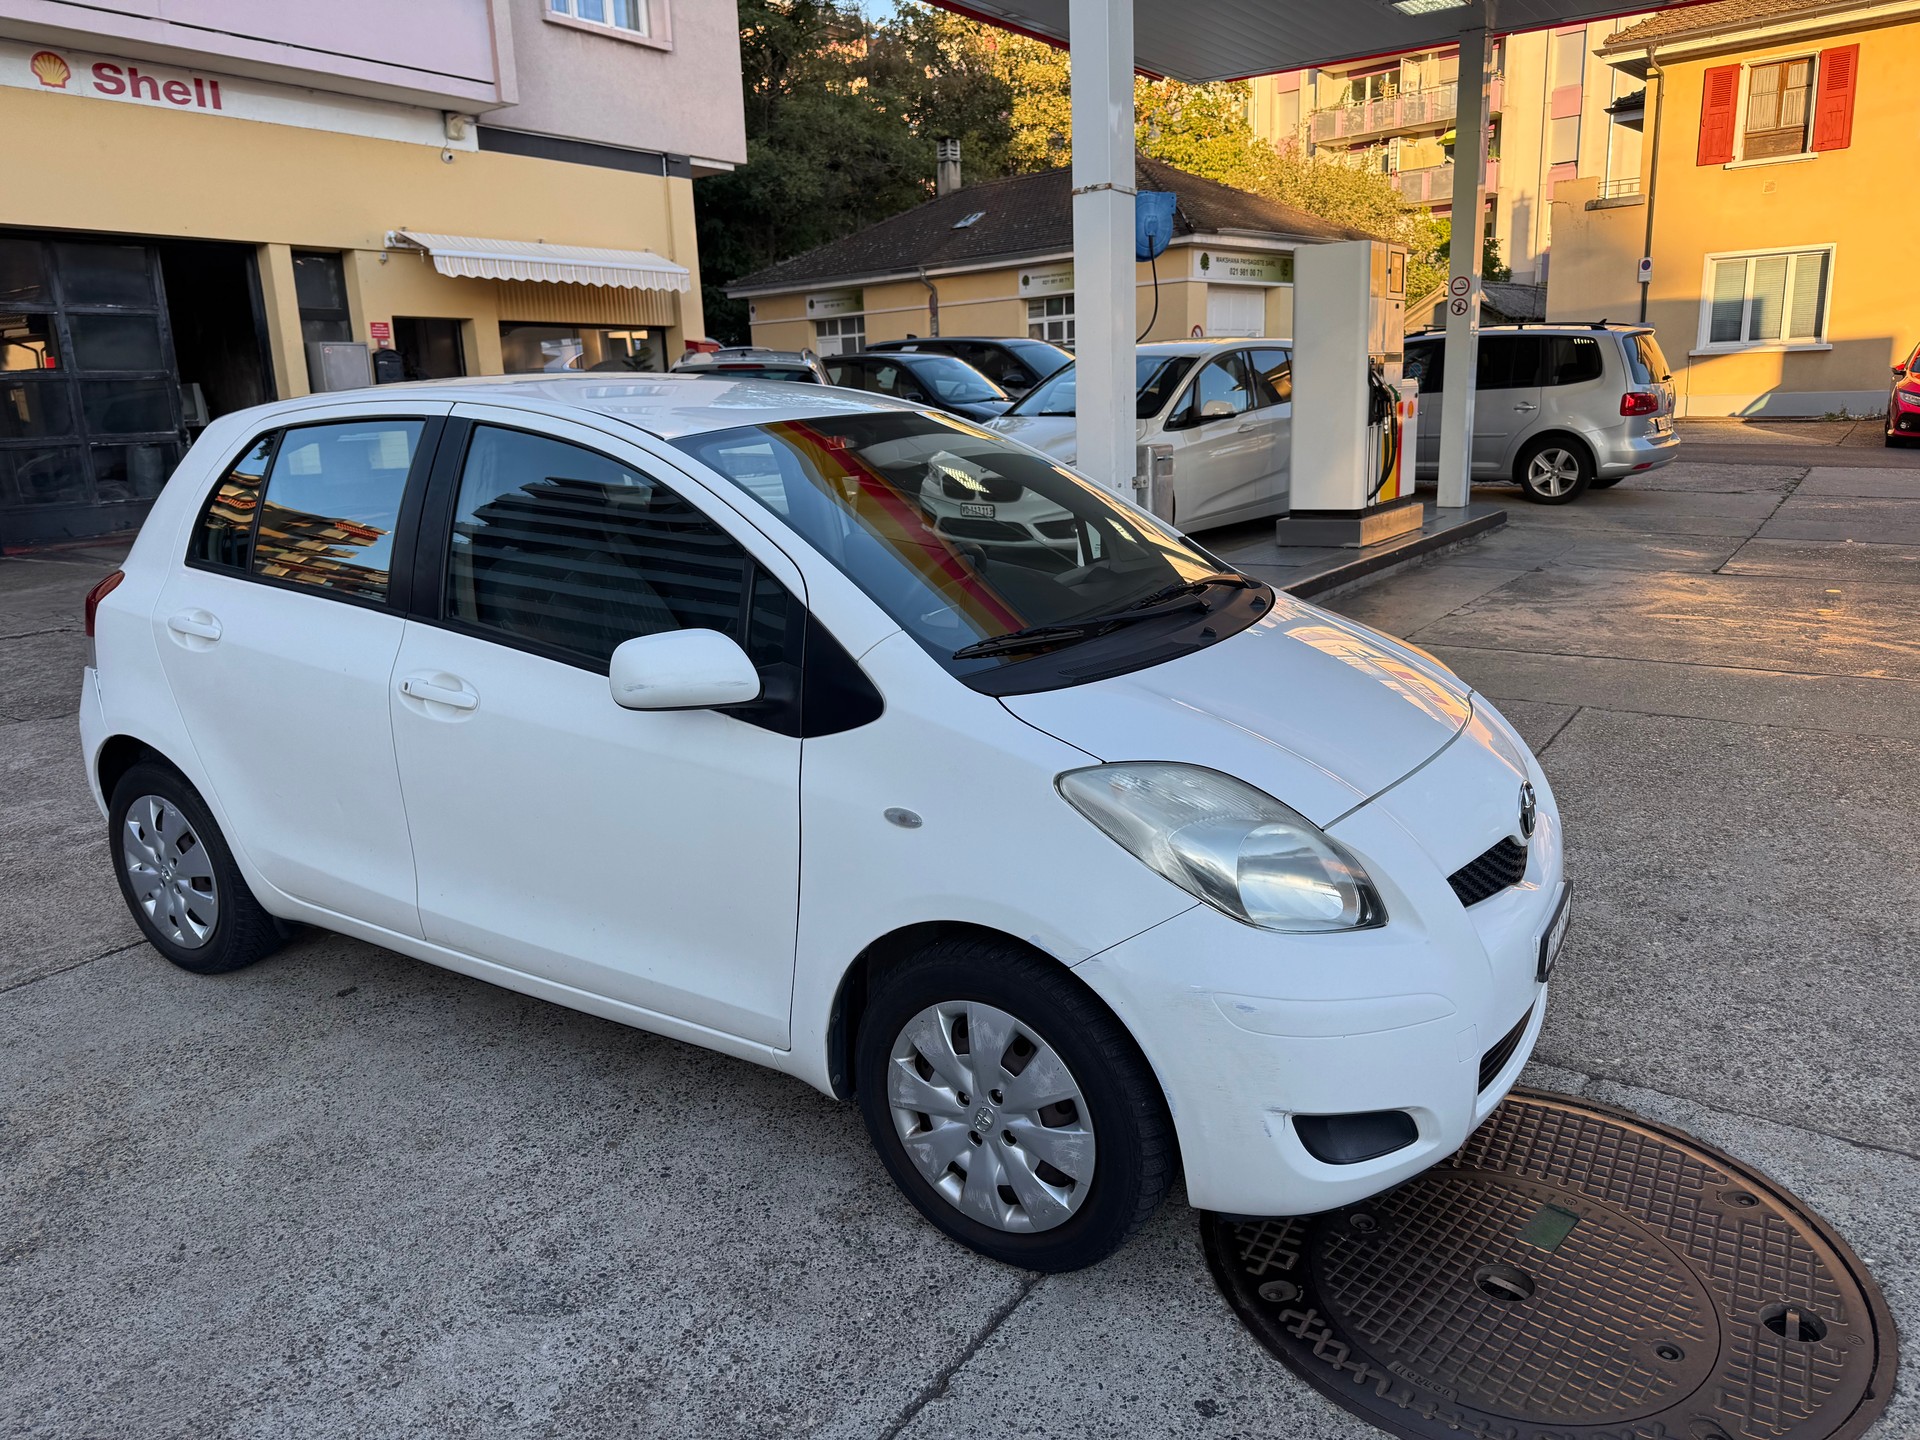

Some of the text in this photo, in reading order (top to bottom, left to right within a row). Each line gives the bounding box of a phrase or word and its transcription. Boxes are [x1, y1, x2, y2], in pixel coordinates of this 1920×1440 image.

[91, 62, 222, 110] Shell
[1229, 267, 1238, 276] 021
[1256, 269, 1263, 277] 71
